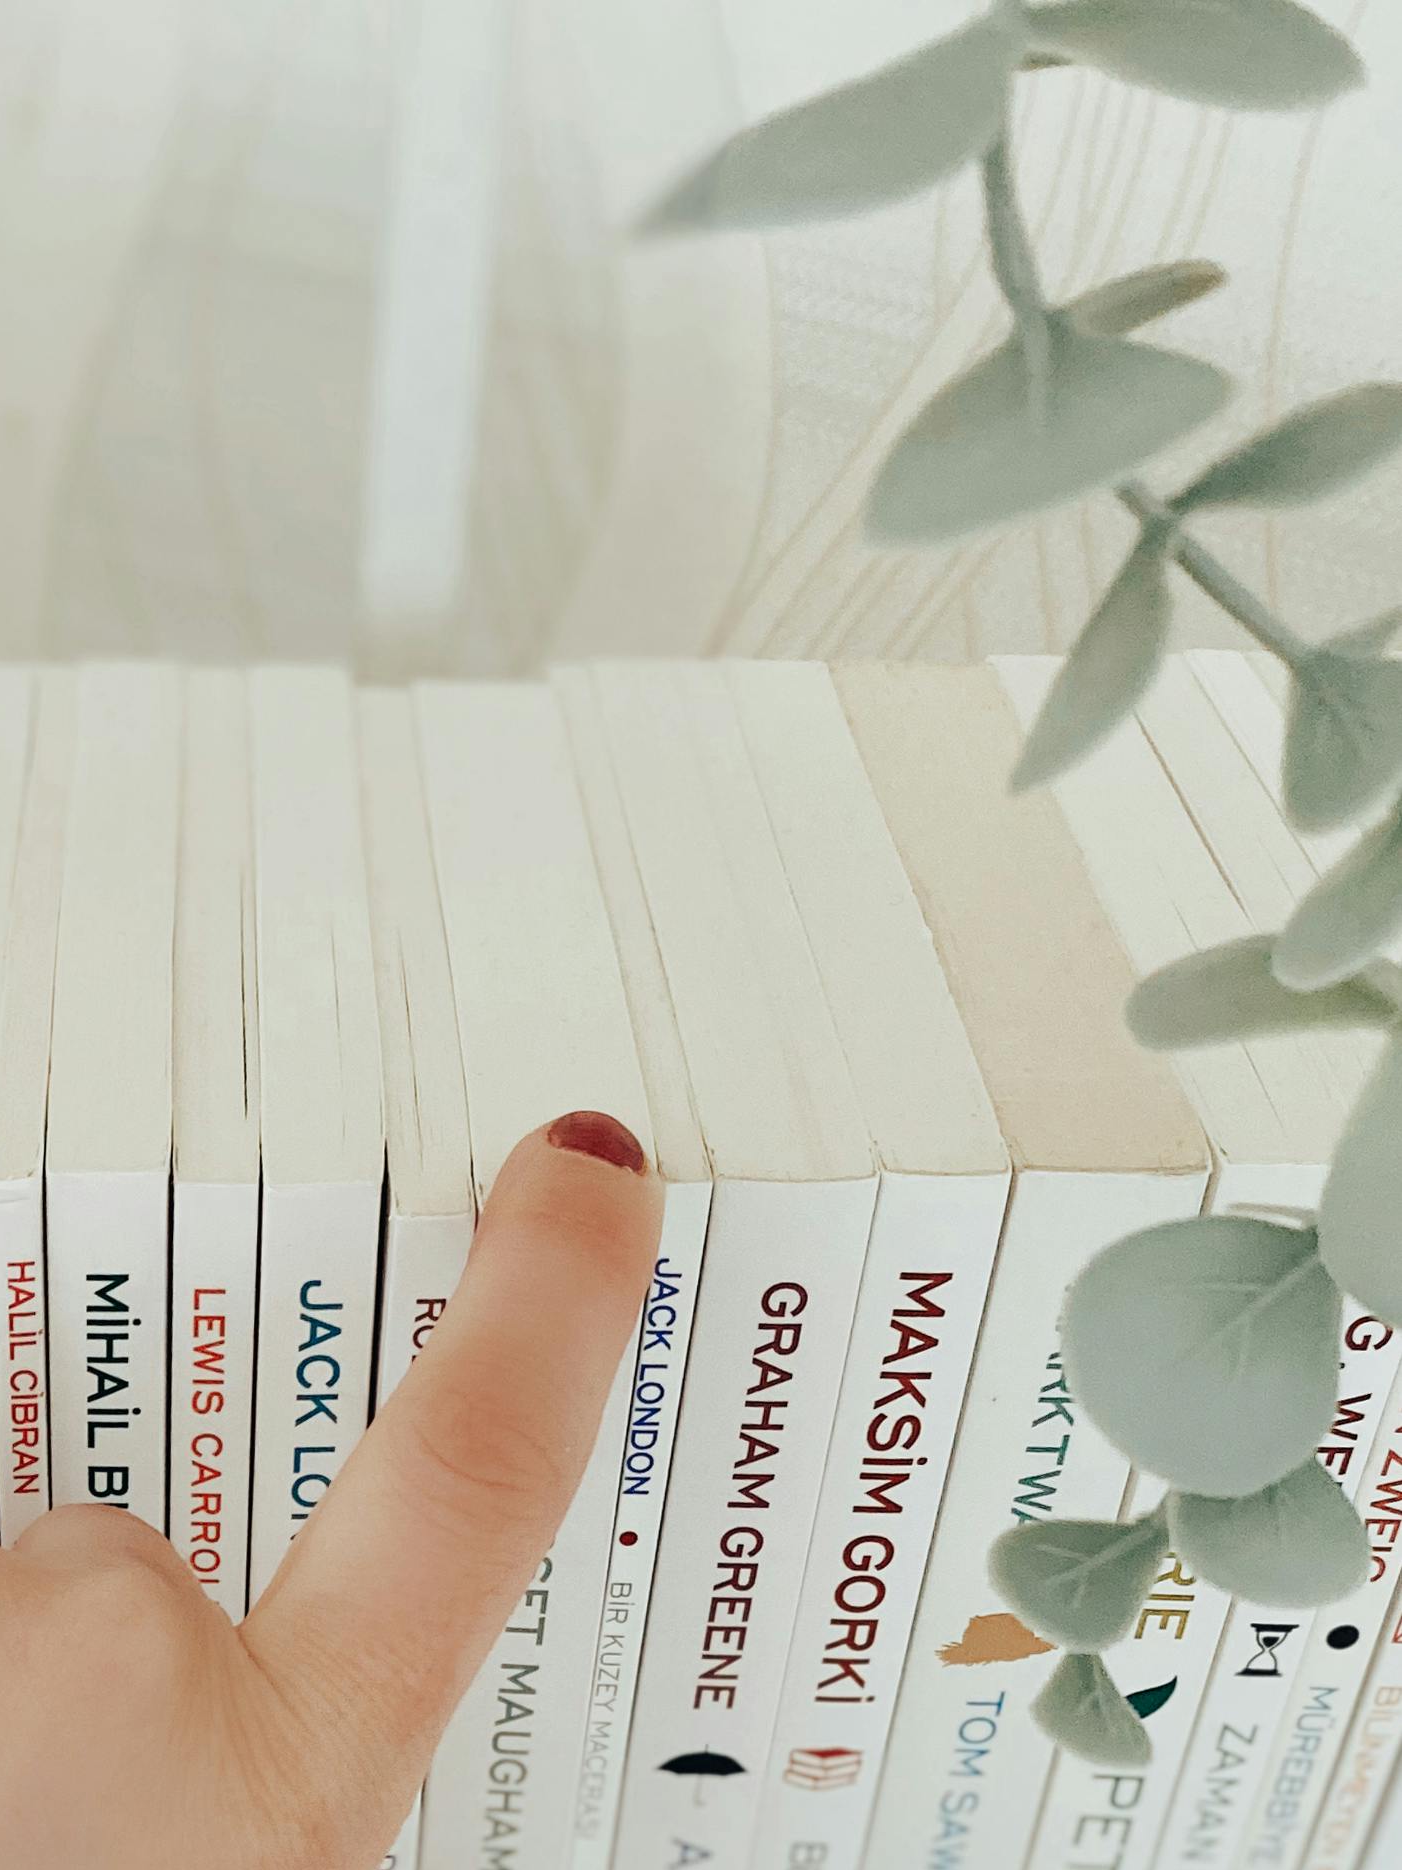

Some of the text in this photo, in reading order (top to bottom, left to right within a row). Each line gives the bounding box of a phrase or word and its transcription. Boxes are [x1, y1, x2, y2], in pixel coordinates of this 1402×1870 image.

[7, 1260, 45, 1495] HALİL CİBRAN
[191, 1288, 227, 1415] LEWIS
[295, 1279, 343, 1427] JACK
[642, 1258, 682, 1351] JACK
[85, 1273, 141, 1510] MİHAİL B
[623, 1363, 669, 1496] LONDON
[727, 1281, 809, 1510] GRAHAM
[852, 1271, 953, 1514] MAKSİM
[592, 1635, 625, 1713] KUZEY
[606, 1581, 633, 1625] BİR
[693, 1526, 764, 1710] GREENE
[815, 1534, 895, 1704] GORKİ
[948, 1691, 1005, 1778] TOM
